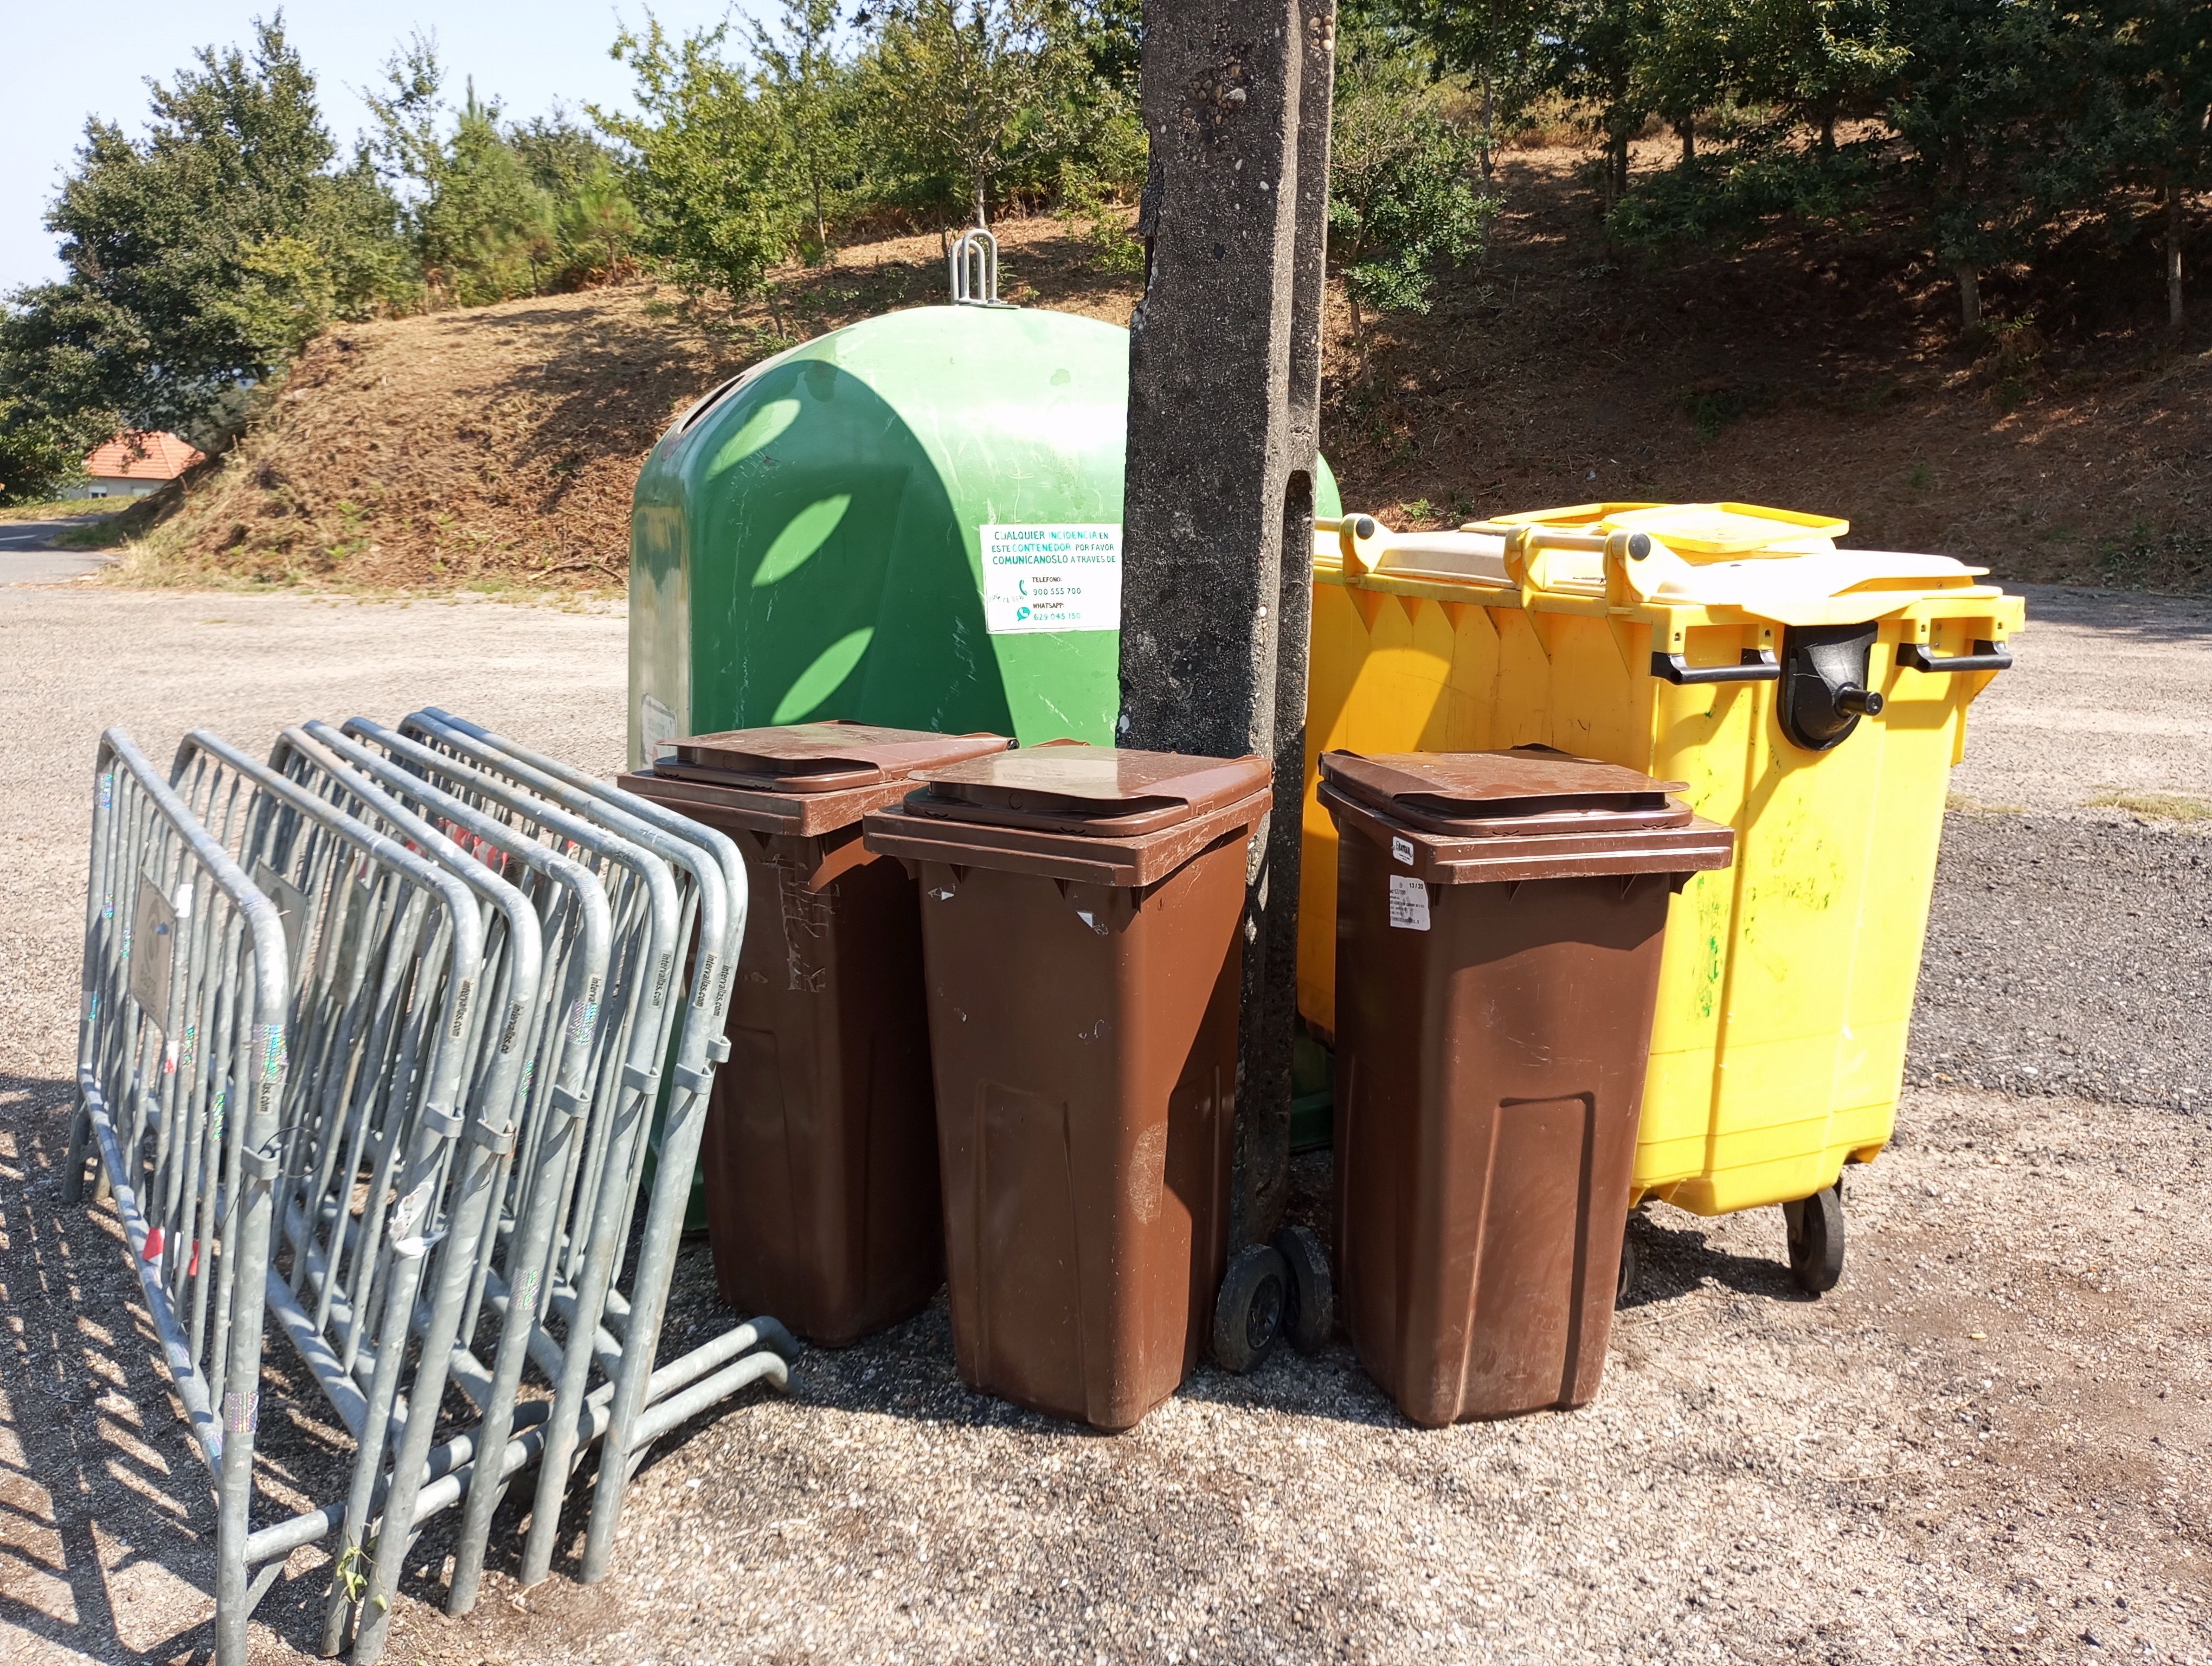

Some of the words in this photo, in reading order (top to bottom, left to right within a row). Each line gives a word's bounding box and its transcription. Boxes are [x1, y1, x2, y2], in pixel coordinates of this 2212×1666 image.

[994, 531, 1045, 540] CUALQUIER
[1049, 531, 1097, 539] INCIDENCIA
[1012, 543, 1071, 552] CONTENEDOR
[652, 953, 671, 1007] intervallas.com
[696, 953, 717, 1007] intervallas.com
[713, 964, 732, 1017] intervallas.com
